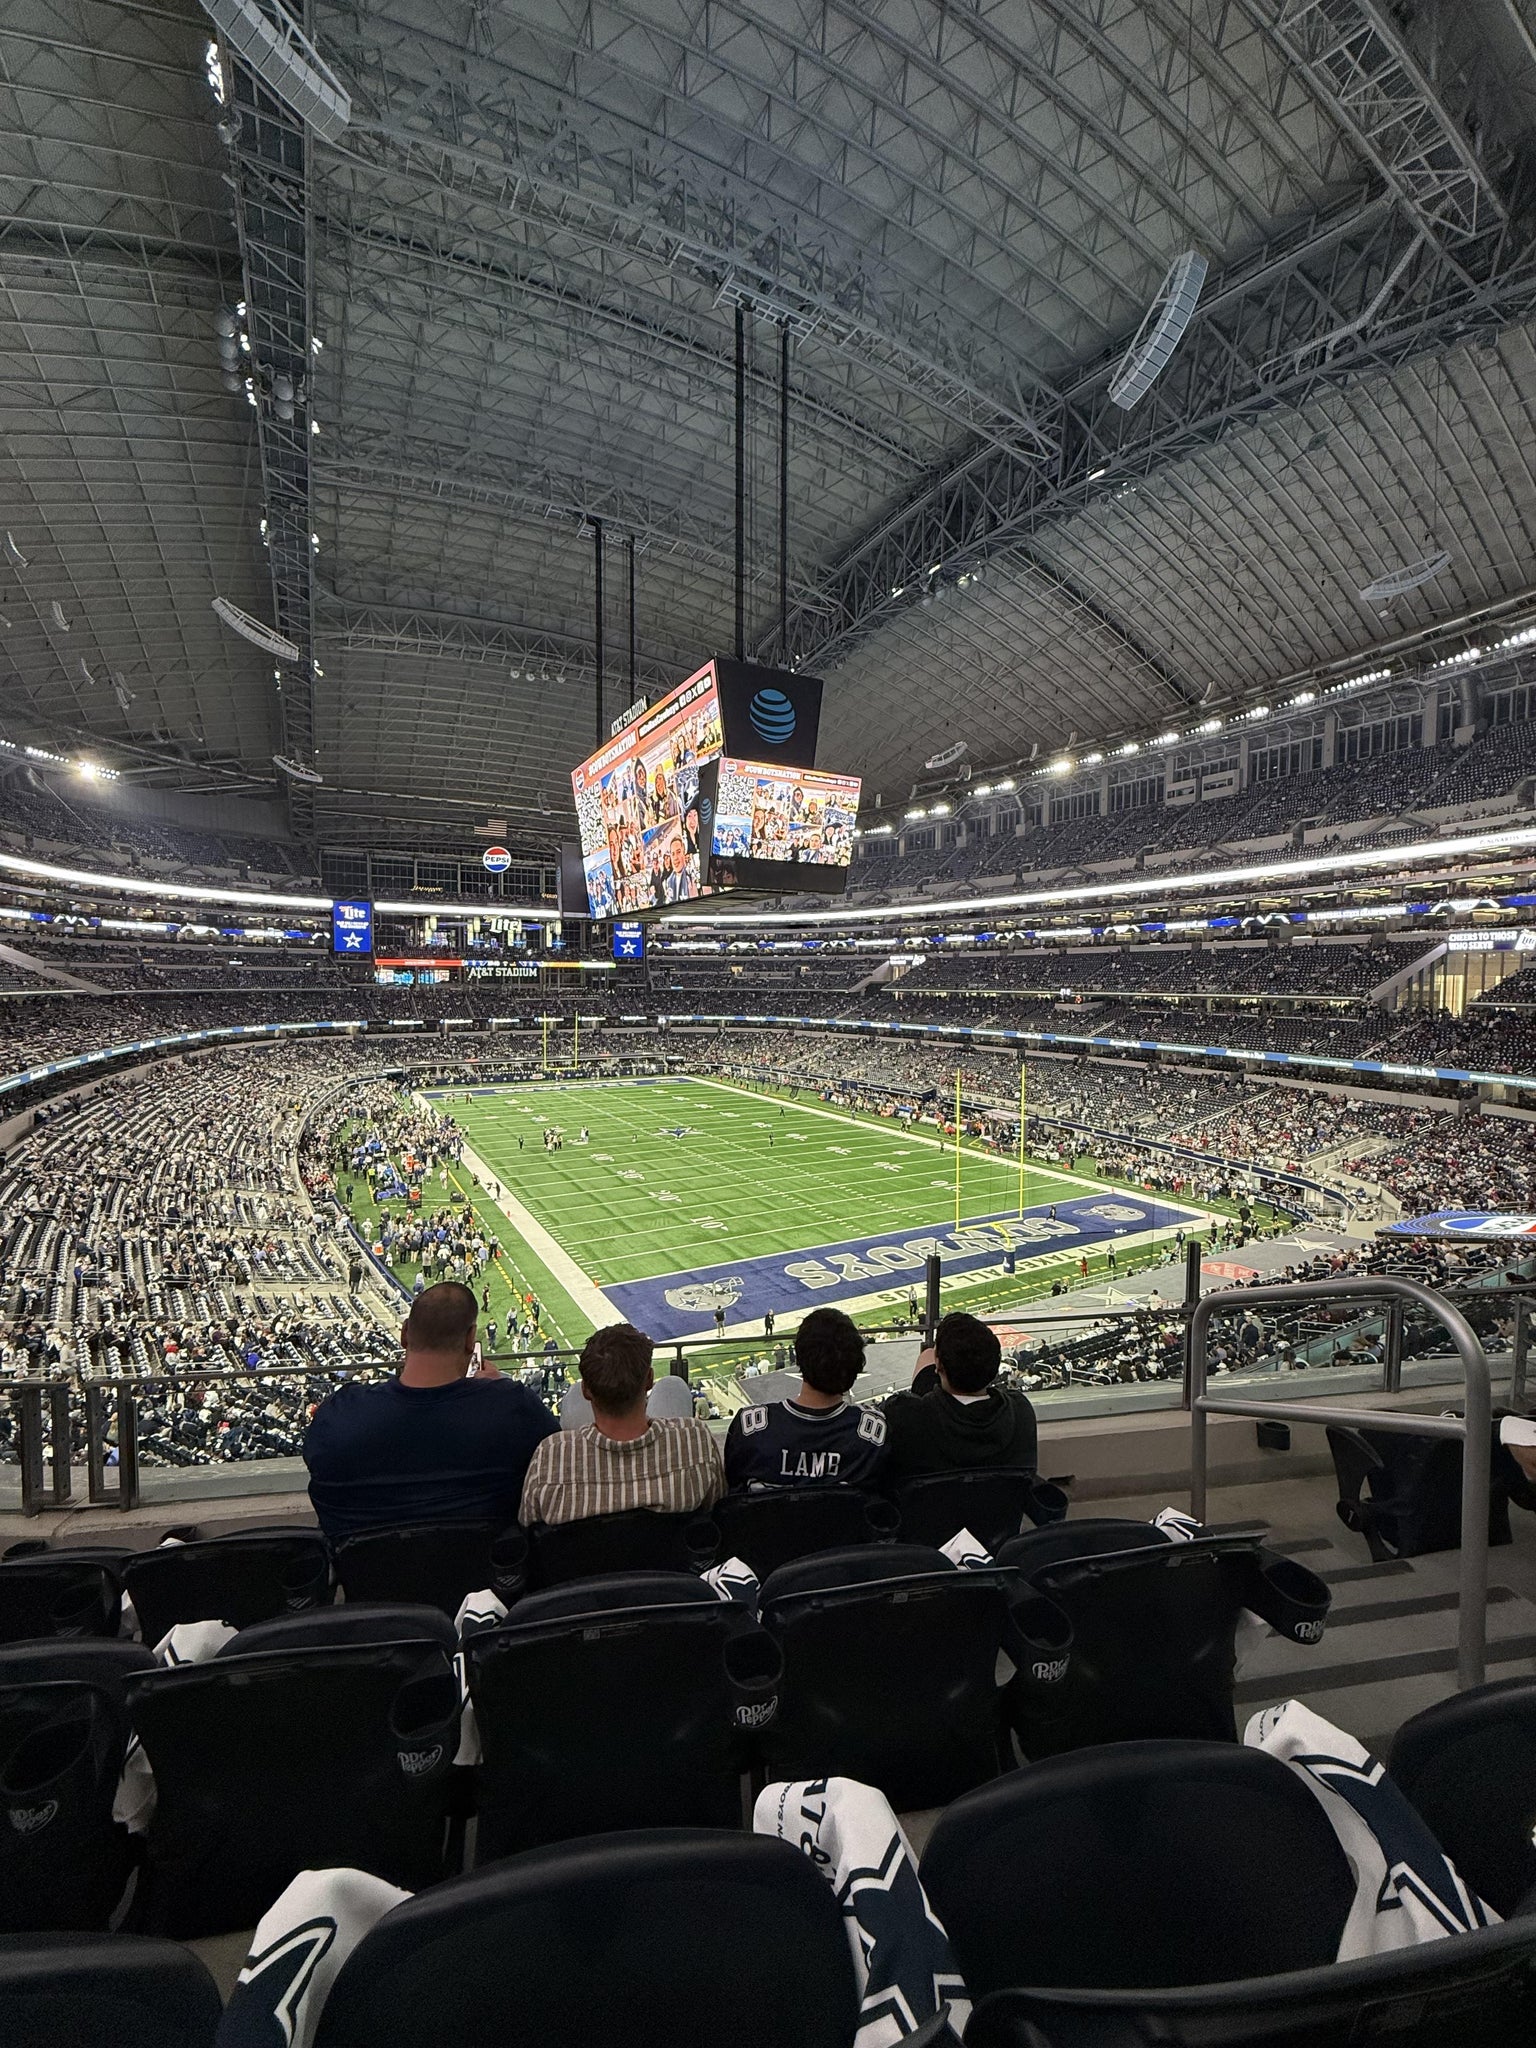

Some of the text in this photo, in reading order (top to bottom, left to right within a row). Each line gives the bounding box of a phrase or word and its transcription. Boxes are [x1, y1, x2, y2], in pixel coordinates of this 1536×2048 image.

[623, 695, 648, 729] STADIUM
[485, 856, 510, 864] PEPSI
[344, 906, 366, 920] Lite
[489, 916, 520, 933] Lite
[1478, 932, 1490, 941] TO
[1490, 930, 1518, 941] THOSE
[1448, 941, 1494, 950] WHO SERVE
[469, 968, 537, 977] AT&T STADIUM
[690, 1215, 724, 1229] 10
[784, 1217, 1081, 1290] COWBOYS
[957, 1268, 1003, 1284] ALL
[877, 1289, 910, 1303] US
[741, 1404, 768, 1436] 8
[857, 1411, 887, 1446] 8
[780, 1449, 841, 1477] LAMB
[737, 1700, 776, 1725] Dr Pepper
